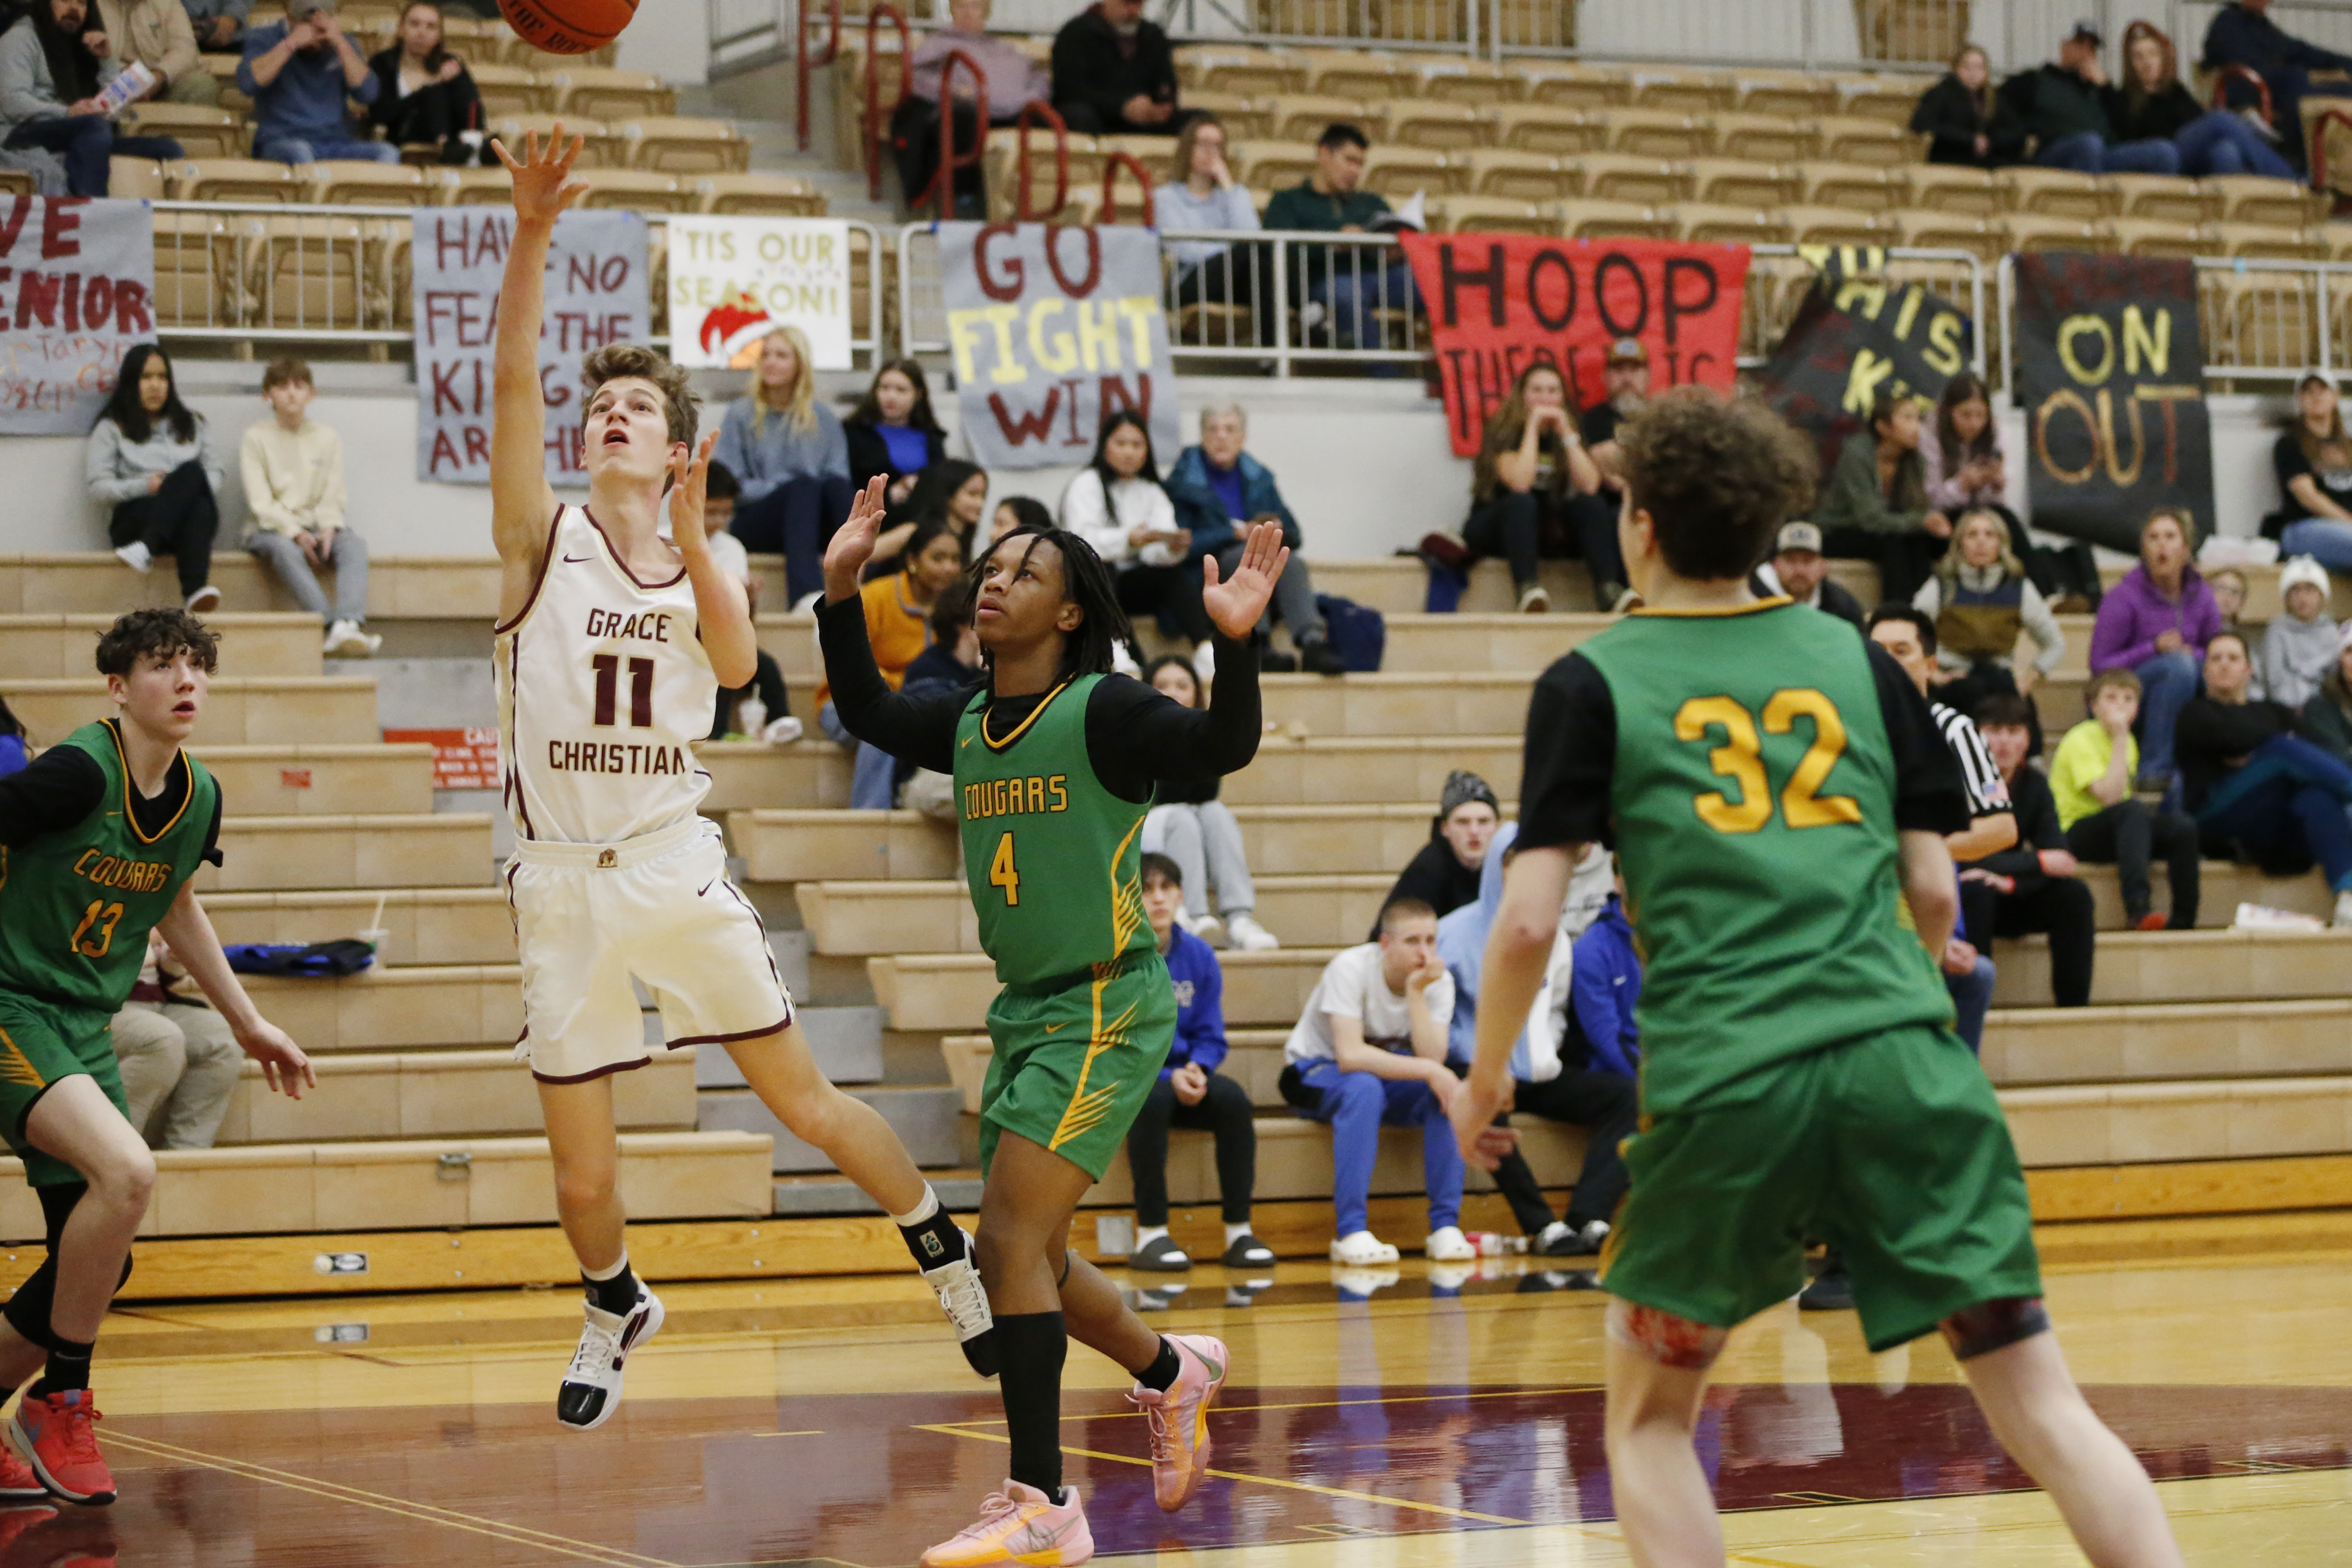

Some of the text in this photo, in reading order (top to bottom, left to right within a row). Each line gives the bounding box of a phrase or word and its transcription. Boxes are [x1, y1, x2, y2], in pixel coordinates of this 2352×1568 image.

[568, 253, 630, 294] NO
[758, 232, 834, 262] OUR
[973, 221, 1102, 302] GO
[553, 311, 632, 353] THE
[1440, 243, 1718, 346] HOOP
[948, 295, 1158, 384] FIGHT
[2057, 304, 2172, 386] ON
[988, 372, 1153, 447] WIN
[2034, 384, 2201, 487] OUT
[586, 608, 672, 643] GRACE
[592, 653, 656, 729] 11
[549, 740, 686, 775] CHRISTIAN
[1673, 687, 1863, 835] 32
[964, 774, 1068, 821] COUGARS
[989, 831, 1020, 906] 4
[71, 899, 125, 958] 13
